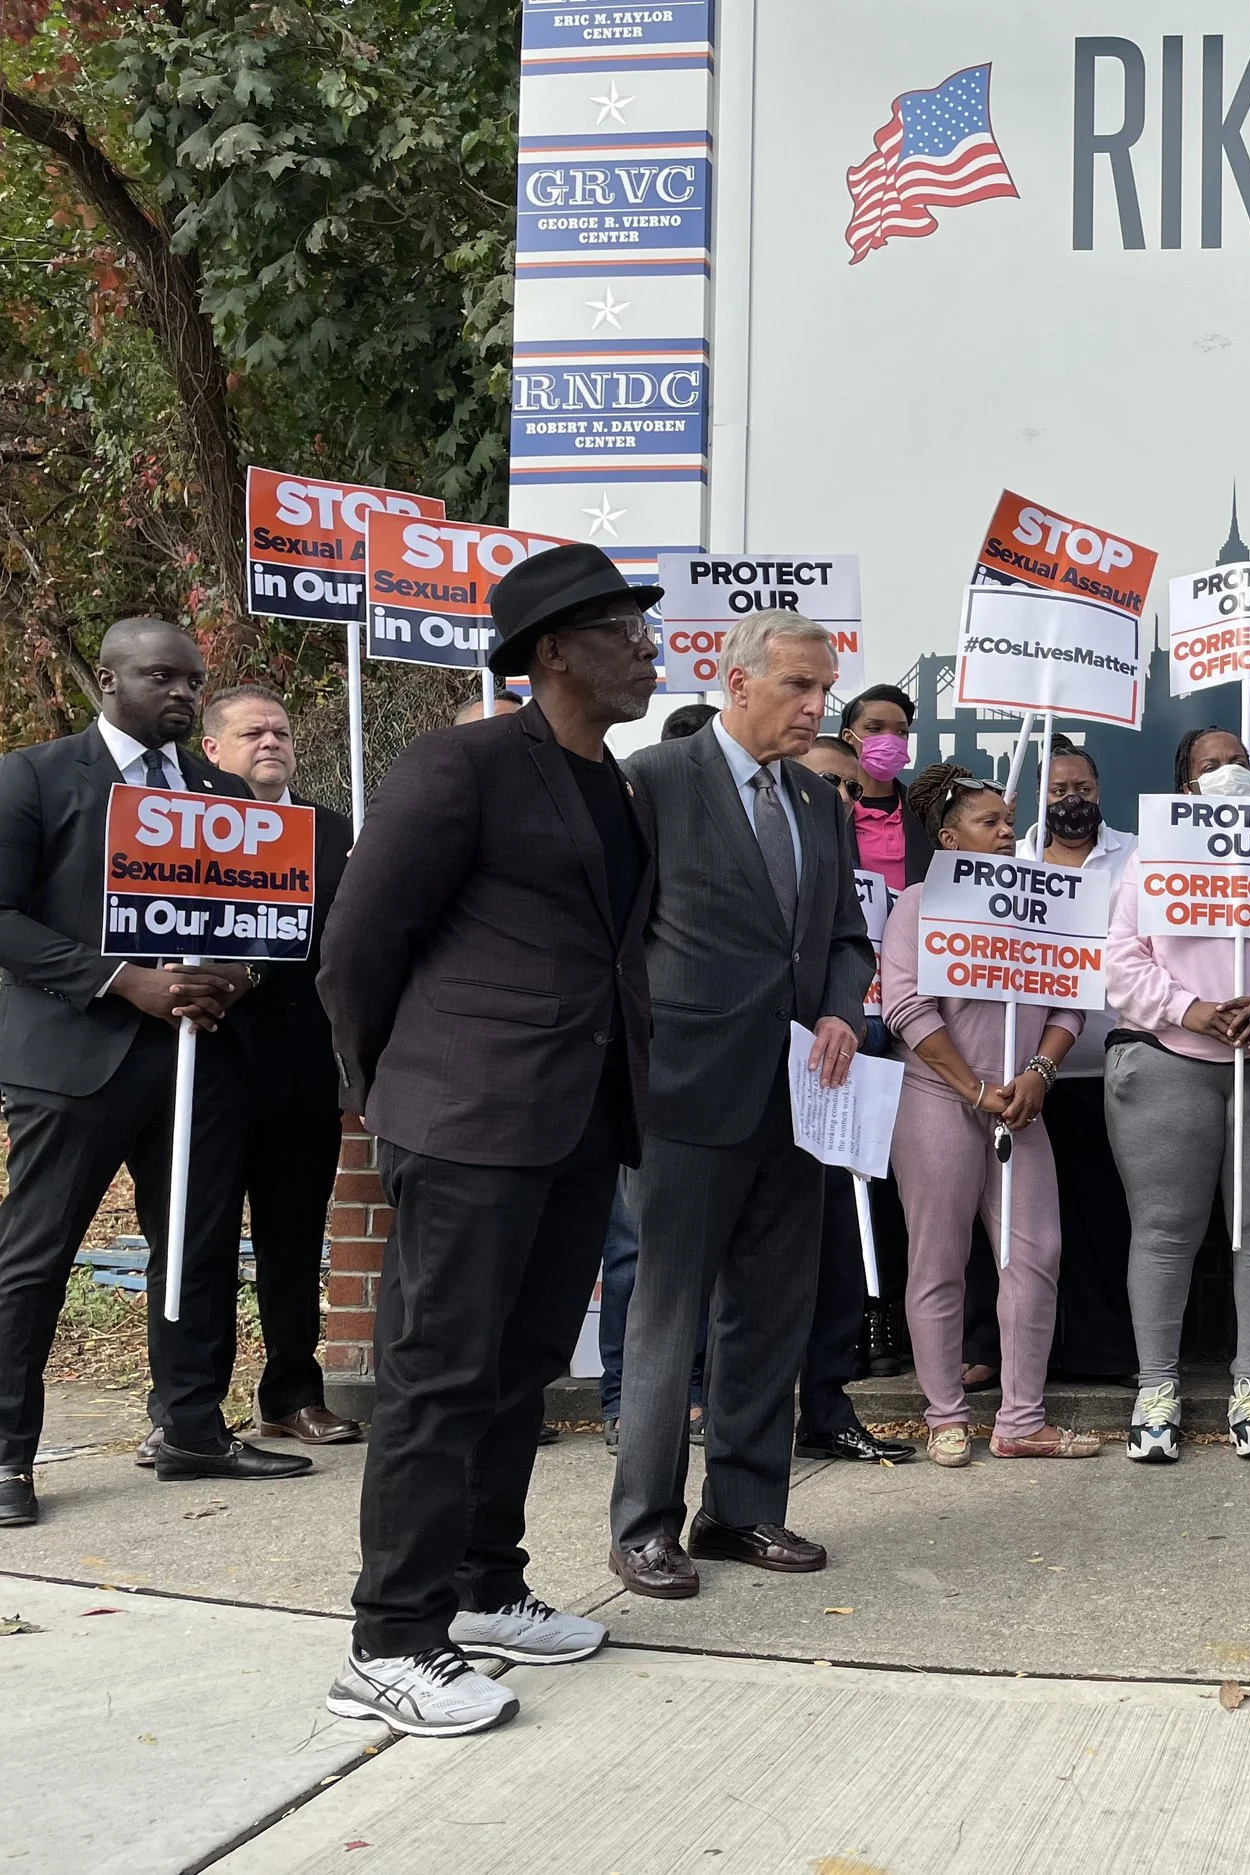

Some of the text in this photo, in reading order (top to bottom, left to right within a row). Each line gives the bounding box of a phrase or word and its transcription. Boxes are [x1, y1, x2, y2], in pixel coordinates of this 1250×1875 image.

[554, 10, 673, 27] ERIC M. TAYLOR
[583, 26, 643, 40] CENTER
[525, 164, 696, 208] GRVC
[537, 214, 682, 233] GEORGE R. VIERNO
[578, 230, 640, 245] CENTER
[513, 370, 700, 412] RNDC
[525, 419, 686, 435] ROBERT N. DAVOREN
[574, 434, 636, 449] CENTER
[253, 526, 343, 561] Sexual
[401, 522, 561, 577] STO
[1011, 506, 1134, 574] STOP
[254, 563, 363, 605] in Our
[374, 569, 478, 606] Sexual
[690, 561, 833, 586] PROTECT
[984, 537, 1059, 581] Sexual
[1060, 567, 1143, 612] Assault
[728, 590, 800, 614] OUR
[374, 606, 496, 652] in Our
[963, 636, 1138, 677] #COsLivesMatter
[135, 794, 284, 856] STOP
[111, 852, 310, 892] Sexual Assault
[953, 859, 1082, 900] PROTECT
[109, 895, 309, 941] in Our Jails!
[988, 892, 1048, 926] OUR
[924, 931, 1101, 973] CORRECTION
[946, 962, 1079, 999] OFFICERS!
[828, 1119, 838, 1151] working
[840, 1112, 848, 1138] women
[837, 1138, 845, 1152] the
